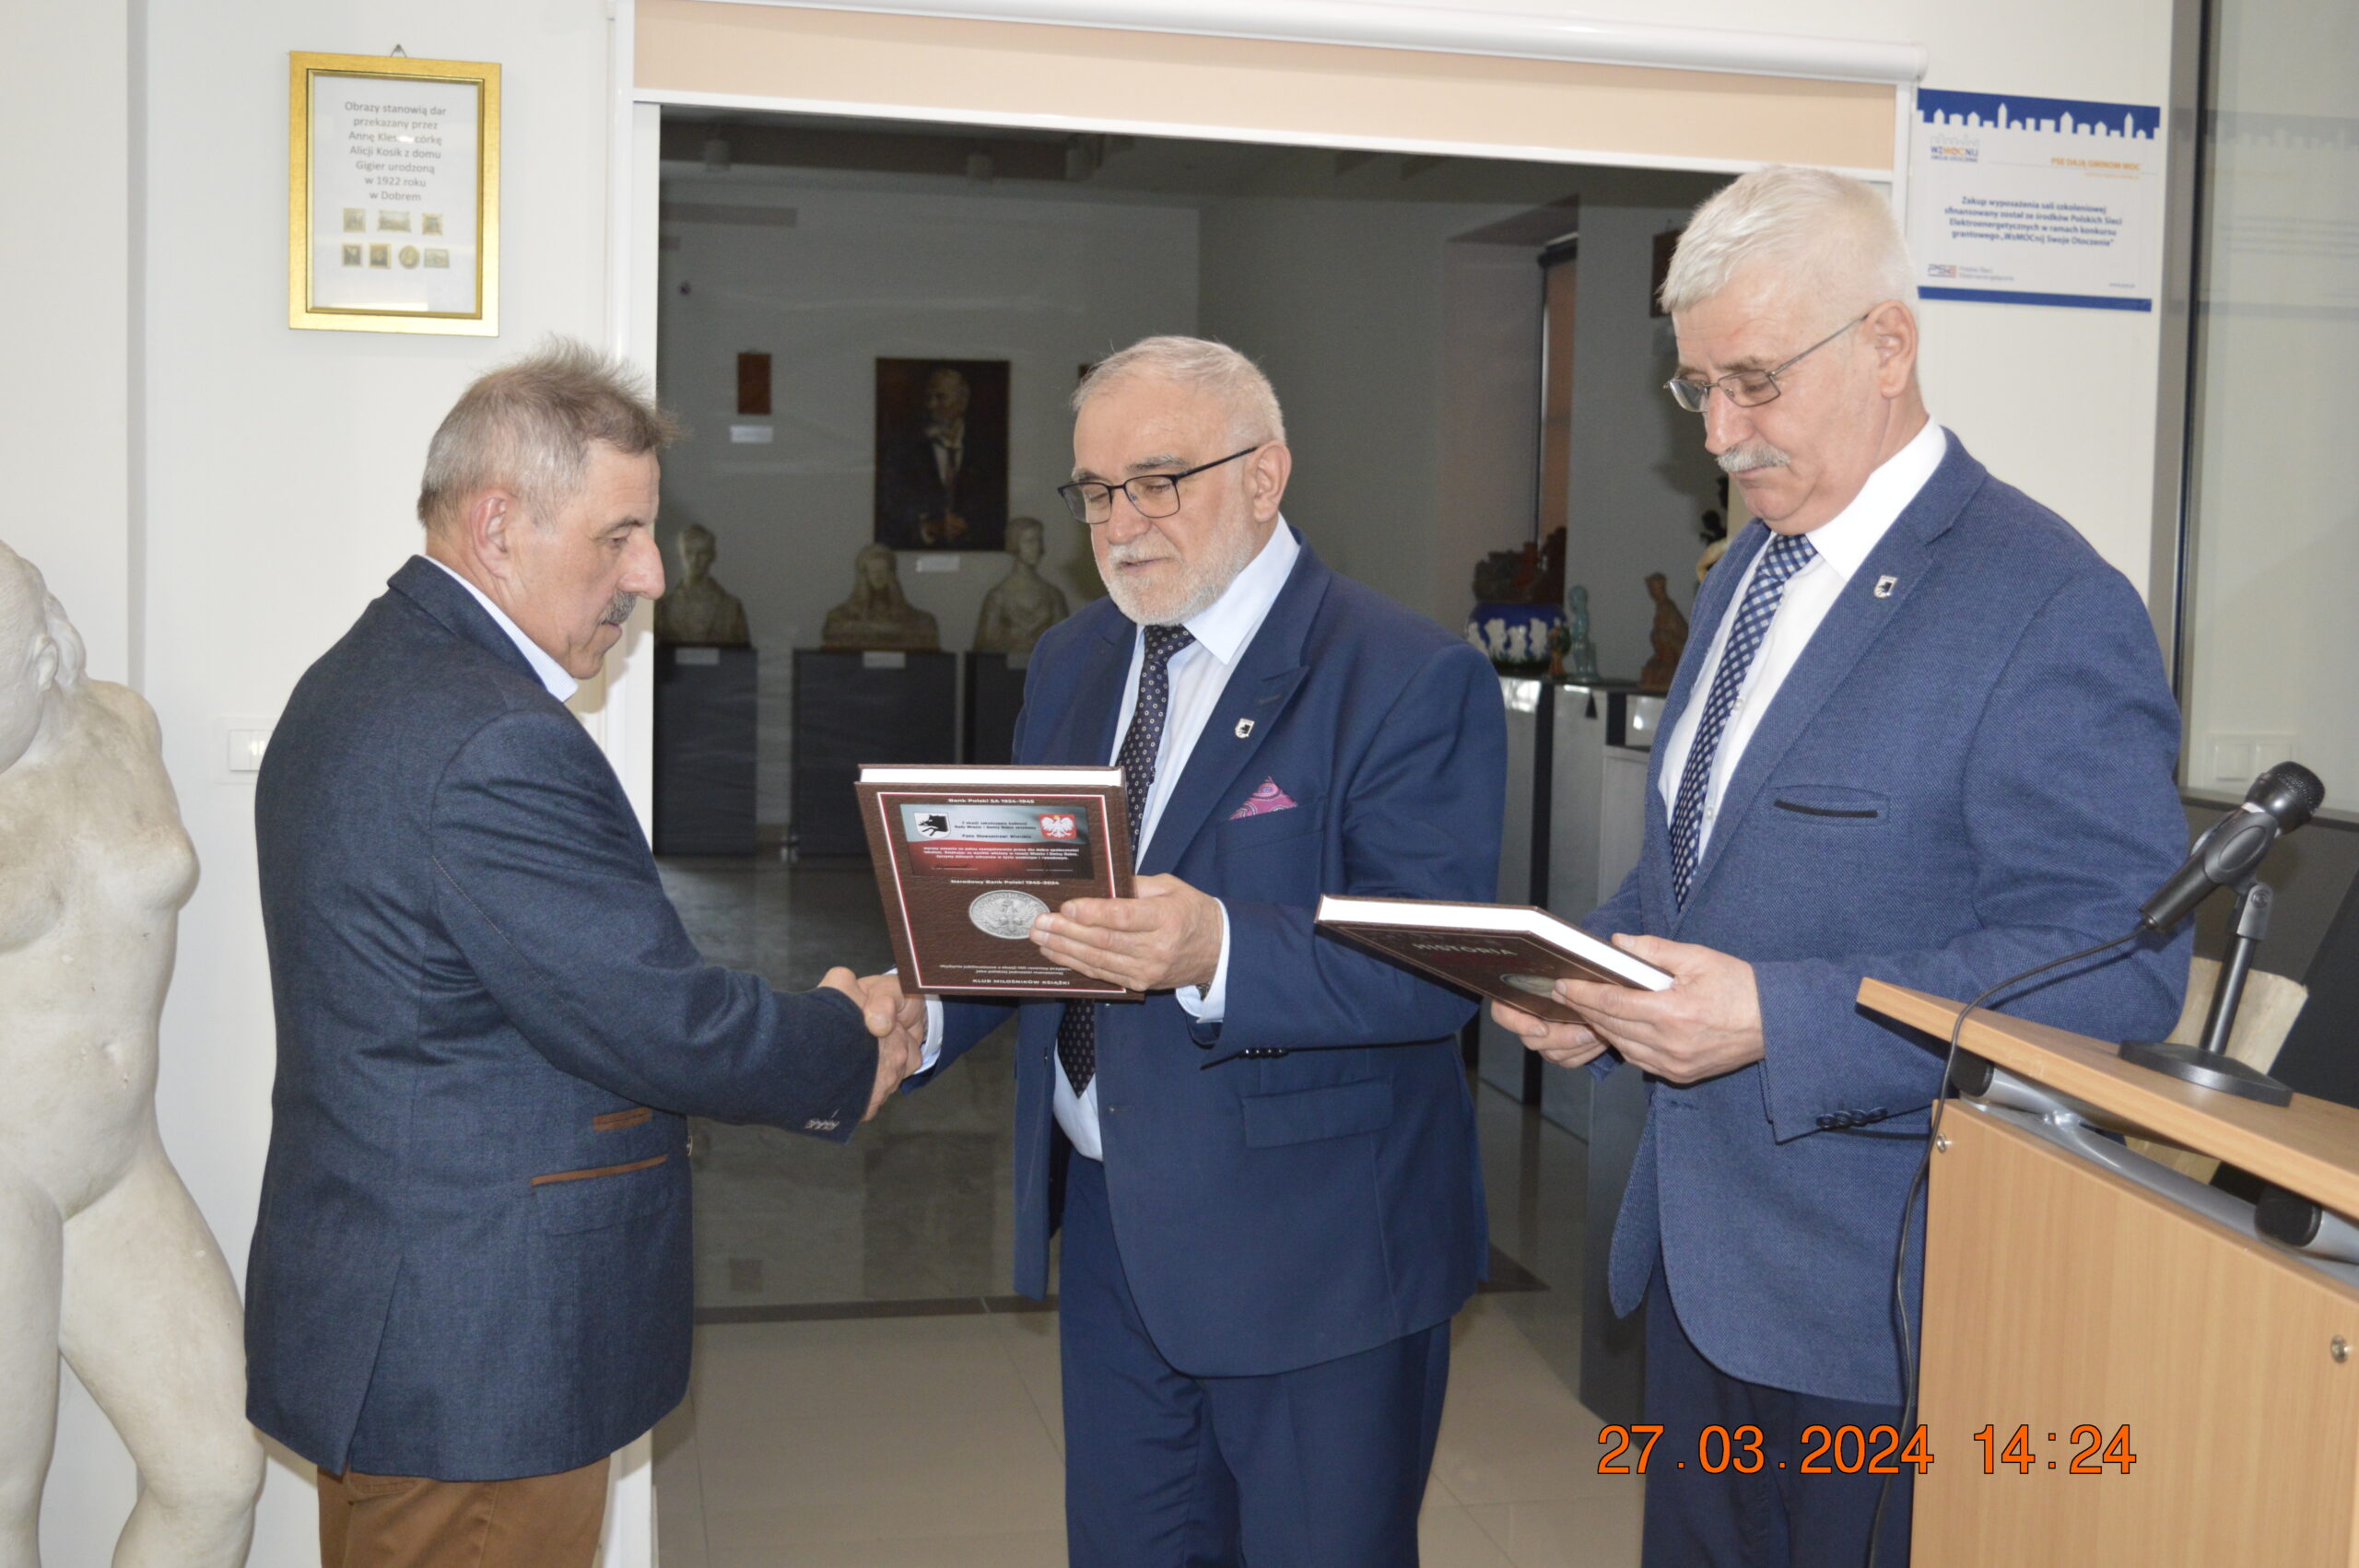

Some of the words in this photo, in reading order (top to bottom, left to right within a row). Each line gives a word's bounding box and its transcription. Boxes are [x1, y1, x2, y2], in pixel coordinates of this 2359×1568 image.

[345, 101, 380, 113] Obrazy
[382, 104, 428, 116] stanowią
[429, 106, 447, 115] dar
[353, 118, 409, 129] przekazany
[412, 121, 439, 131] przez
[348, 131, 375, 143] Annę
[414, 135, 442, 146] córkę
[349, 146, 373, 158] Alicji
[376, 147, 402, 158] Kosik
[412, 148, 441, 159] domu
[356, 160, 385, 172] Gigier
[388, 163, 435, 175] urodzoną
[376, 176, 402, 186] 1922
[404, 178, 427, 187] roku
[370, 192, 379, 200] w
[381, 191, 421, 201] Dobrem
[1962, 195, 1987, 207] Zakup
[1989, 199, 2039, 208] wyposażenia
[1413, 942, 1519, 956] HISTORIA
